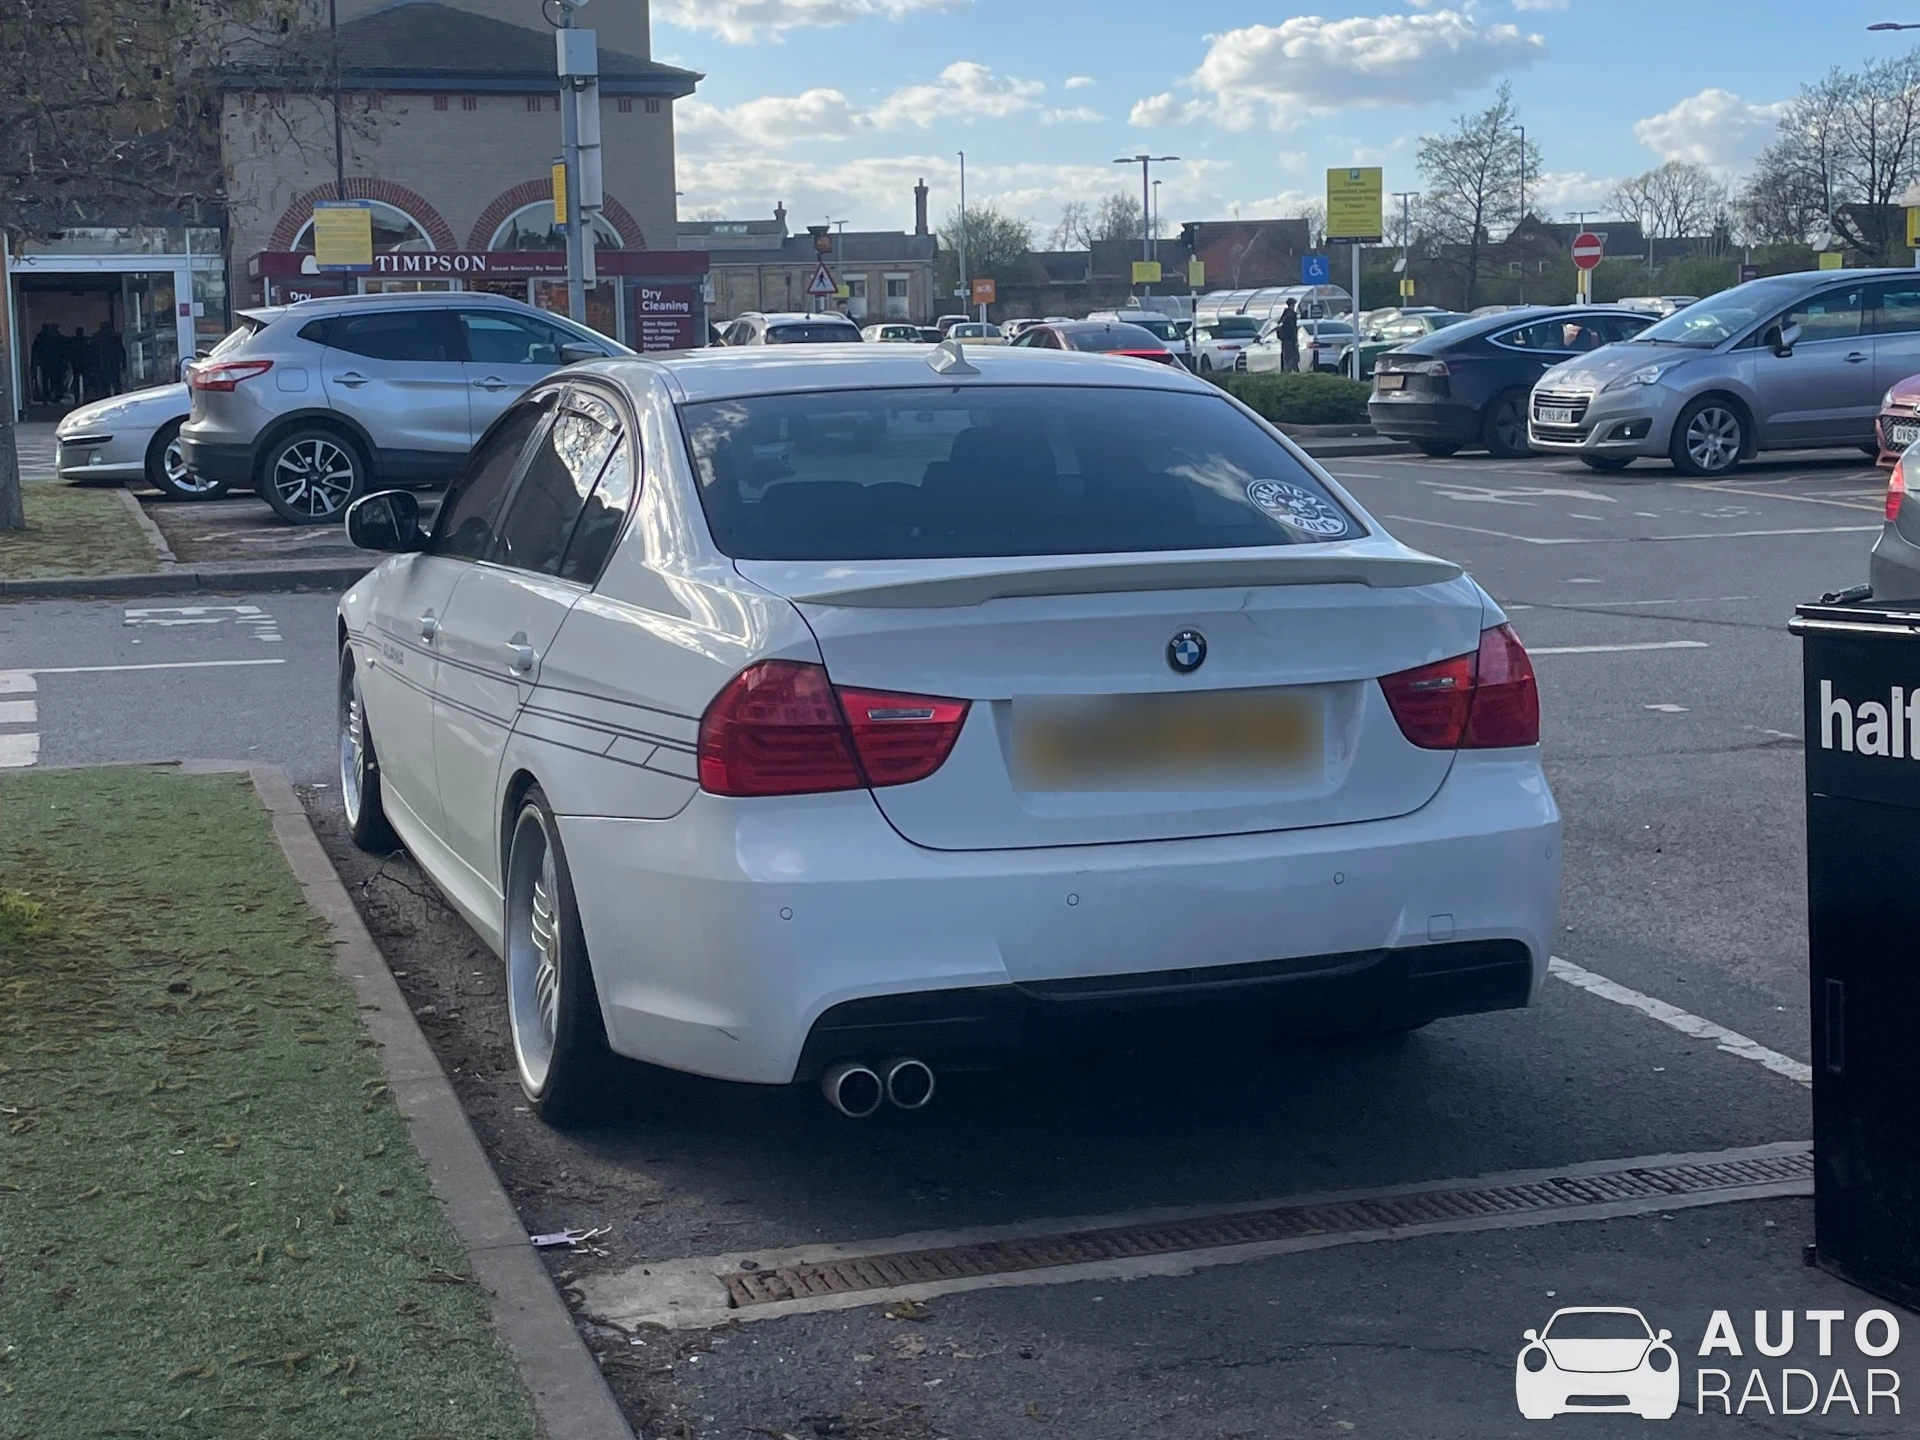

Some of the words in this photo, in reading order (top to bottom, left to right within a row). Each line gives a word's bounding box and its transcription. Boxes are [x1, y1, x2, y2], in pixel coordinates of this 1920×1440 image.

[375, 255, 486, 272] TIMPSON
[641, 288, 662, 300] Dry
[642, 300, 689, 313] Cleaning
[1256, 483, 1328, 509] CHEMICAL
[1294, 517, 1339, 532] GUYS
